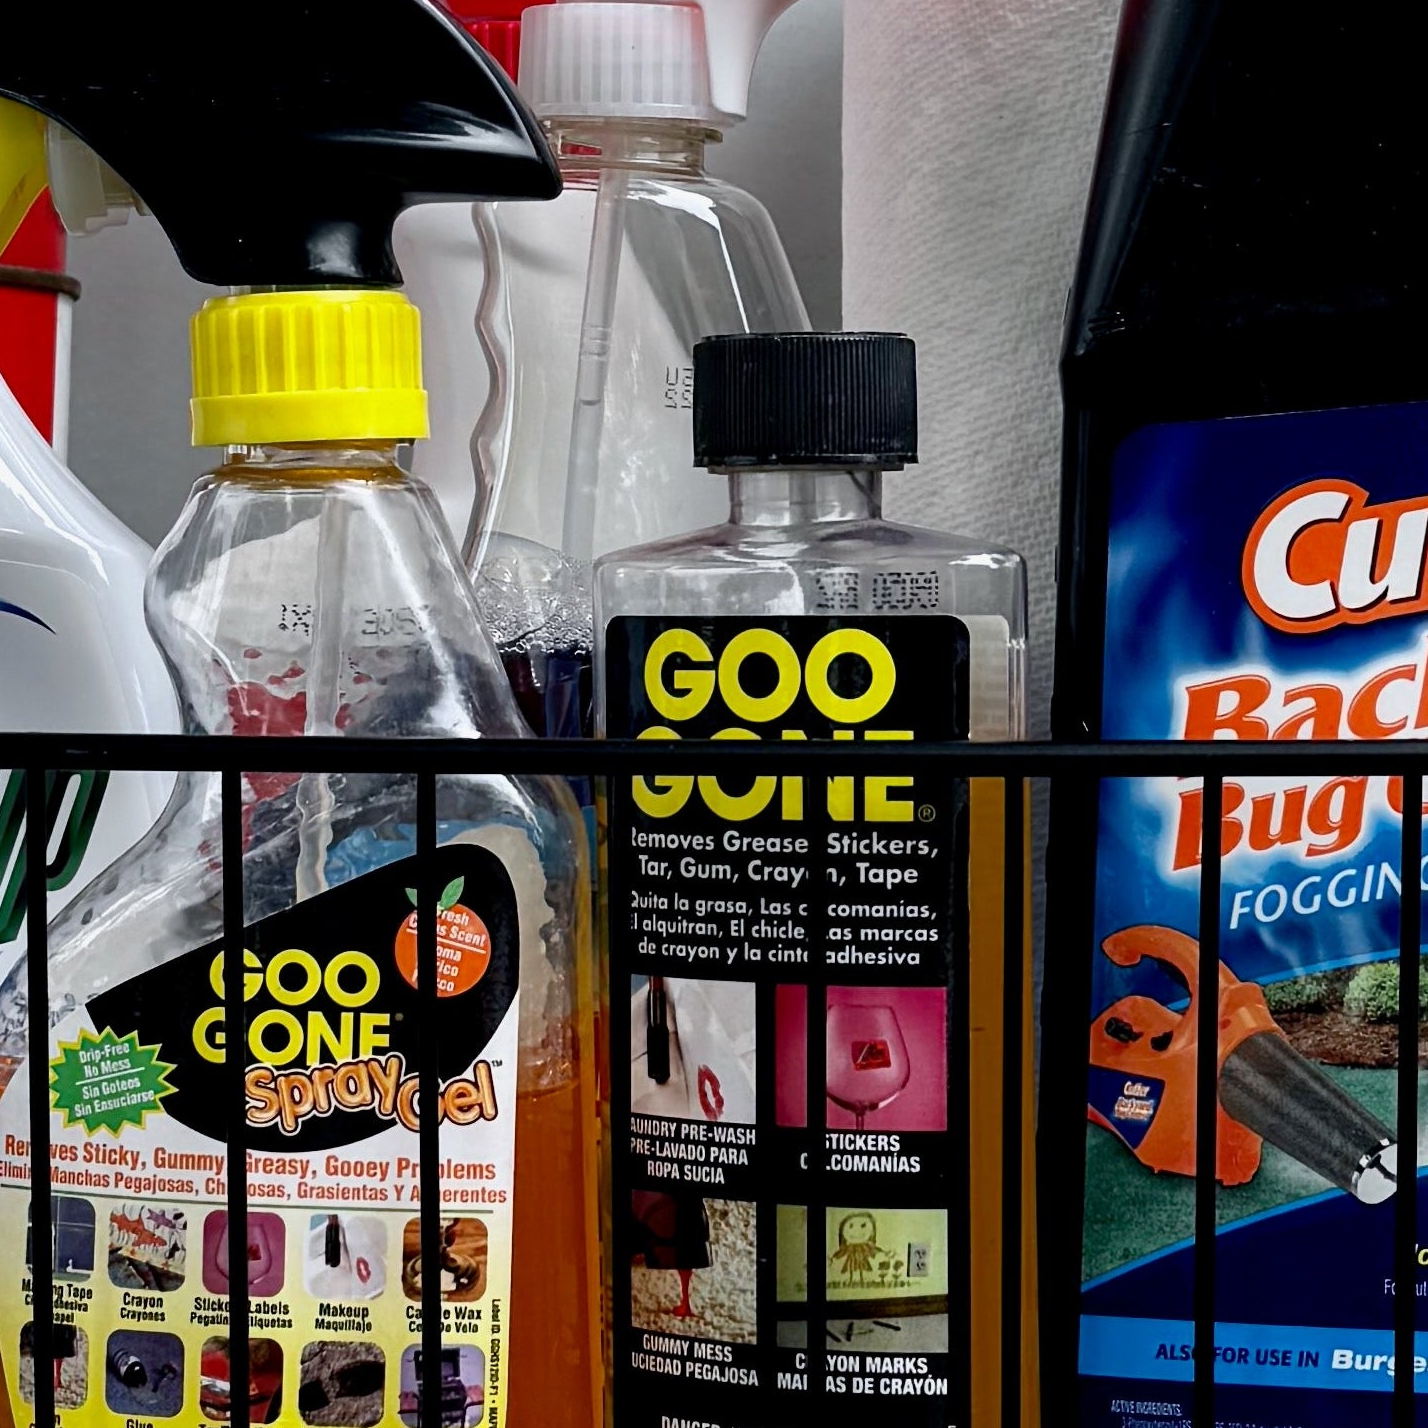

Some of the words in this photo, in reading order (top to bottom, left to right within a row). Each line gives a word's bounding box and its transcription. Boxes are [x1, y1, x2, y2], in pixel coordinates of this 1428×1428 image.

[645, 628, 896, 723] GOO
[1172, 775, 1369, 872] Bug
[827, 832, 939, 859] Stickers,
[639, 855, 673, 880] Tar,
[680, 857, 740, 883] Gum,
[748, 860, 846, 888] Crayn,
[856, 862, 919, 890] Tape
[675, 892, 689, 911] la
[695, 900, 754, 916] grasa,
[760, 898, 792, 916] Las
[449, 926, 486, 947] Scent
[642, 914, 723, 938] alquitran,
[730, 919, 744, 938] El
[860, 926, 939, 942] marcas
[638, 936, 656, 954] de
[662, 943, 719, 963] crayon
[727, 946, 738, 965] y
[744, 942, 761, 961] la
[826, 945, 920, 966] adhesiva
[210, 948, 380, 1007] GOO
[79, 1042, 131, 1064] Drip-Free
[85, 1063, 99, 1078] No
[102, 1057, 132, 1075] Mess
[82, 1085, 101, 1101] Sin
[103, 1077, 142, 1095] Goteos
[75, 1102, 93, 1118] Sin
[94, 1090, 156, 1115] Ensuciarse
[681, 1124, 756, 1146] PRE-WASH
[83, 1142, 147, 1171] Sticky,
[631, 1137, 706, 1162] PRE-LAVADO
[710, 1148, 748, 1166] PARA
[325, 1155, 390, 1182] Gooey
[647, 1160, 680, 1180] ROPA
[684, 1165, 725, 1184] SUCIA
[114, 1172, 199, 1197] Pegajosas,
[297, 1181, 389, 1201] Grasientas
[123, 1292, 164, 1310] Crayon
[318, 1303, 370, 1321] Makeup
[454, 1306, 482, 1320] Wax
[643, 1333, 689, 1356] GUMMY
[694, 1342, 733, 1363] MESS
[1214, 1346, 1249, 1365] FOR
[1255, 1349, 1292, 1367] USE
[1298, 1350, 1320, 1368] IN
[686, 1364, 759, 1387] PEGAJOSA
[865, 1356, 928, 1374] MARKS
[852, 1376, 874, 1394] DE
[879, 1374, 948, 1395] CRAYÓN
